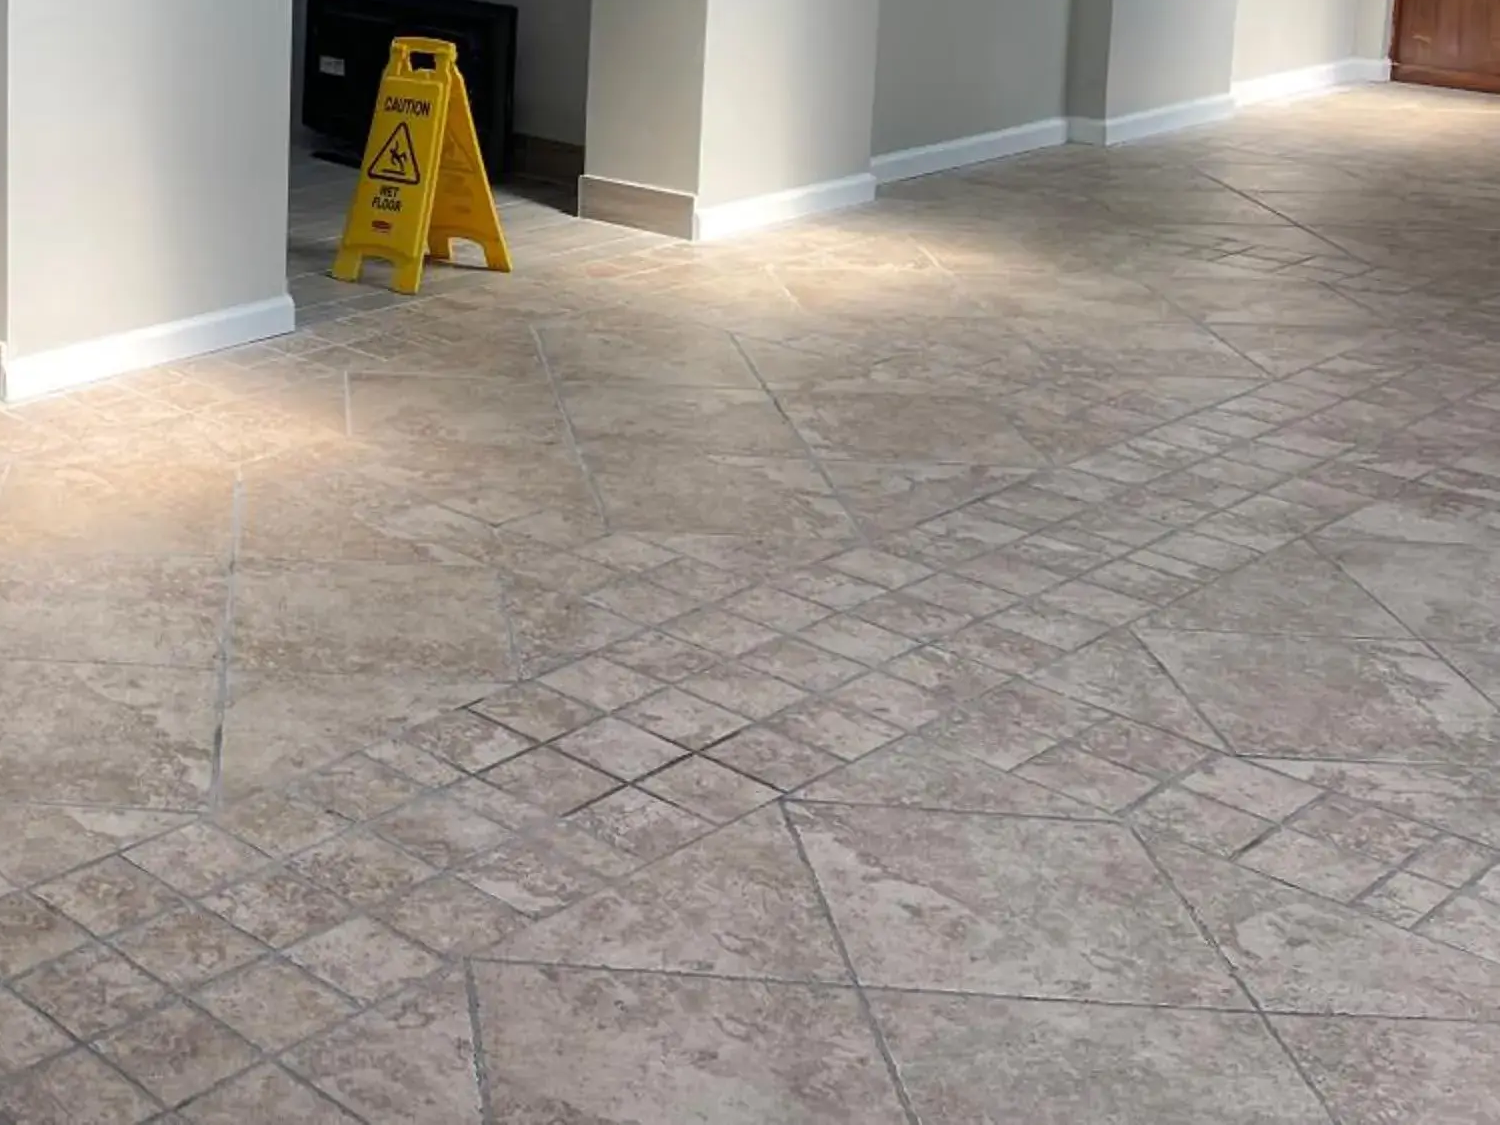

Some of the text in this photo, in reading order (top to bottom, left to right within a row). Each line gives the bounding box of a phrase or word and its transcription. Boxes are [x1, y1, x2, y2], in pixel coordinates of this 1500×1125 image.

[384, 96, 431, 116] CAUTION
[379, 186, 399, 198] WET
[372, 197, 402, 212] FLOOR
